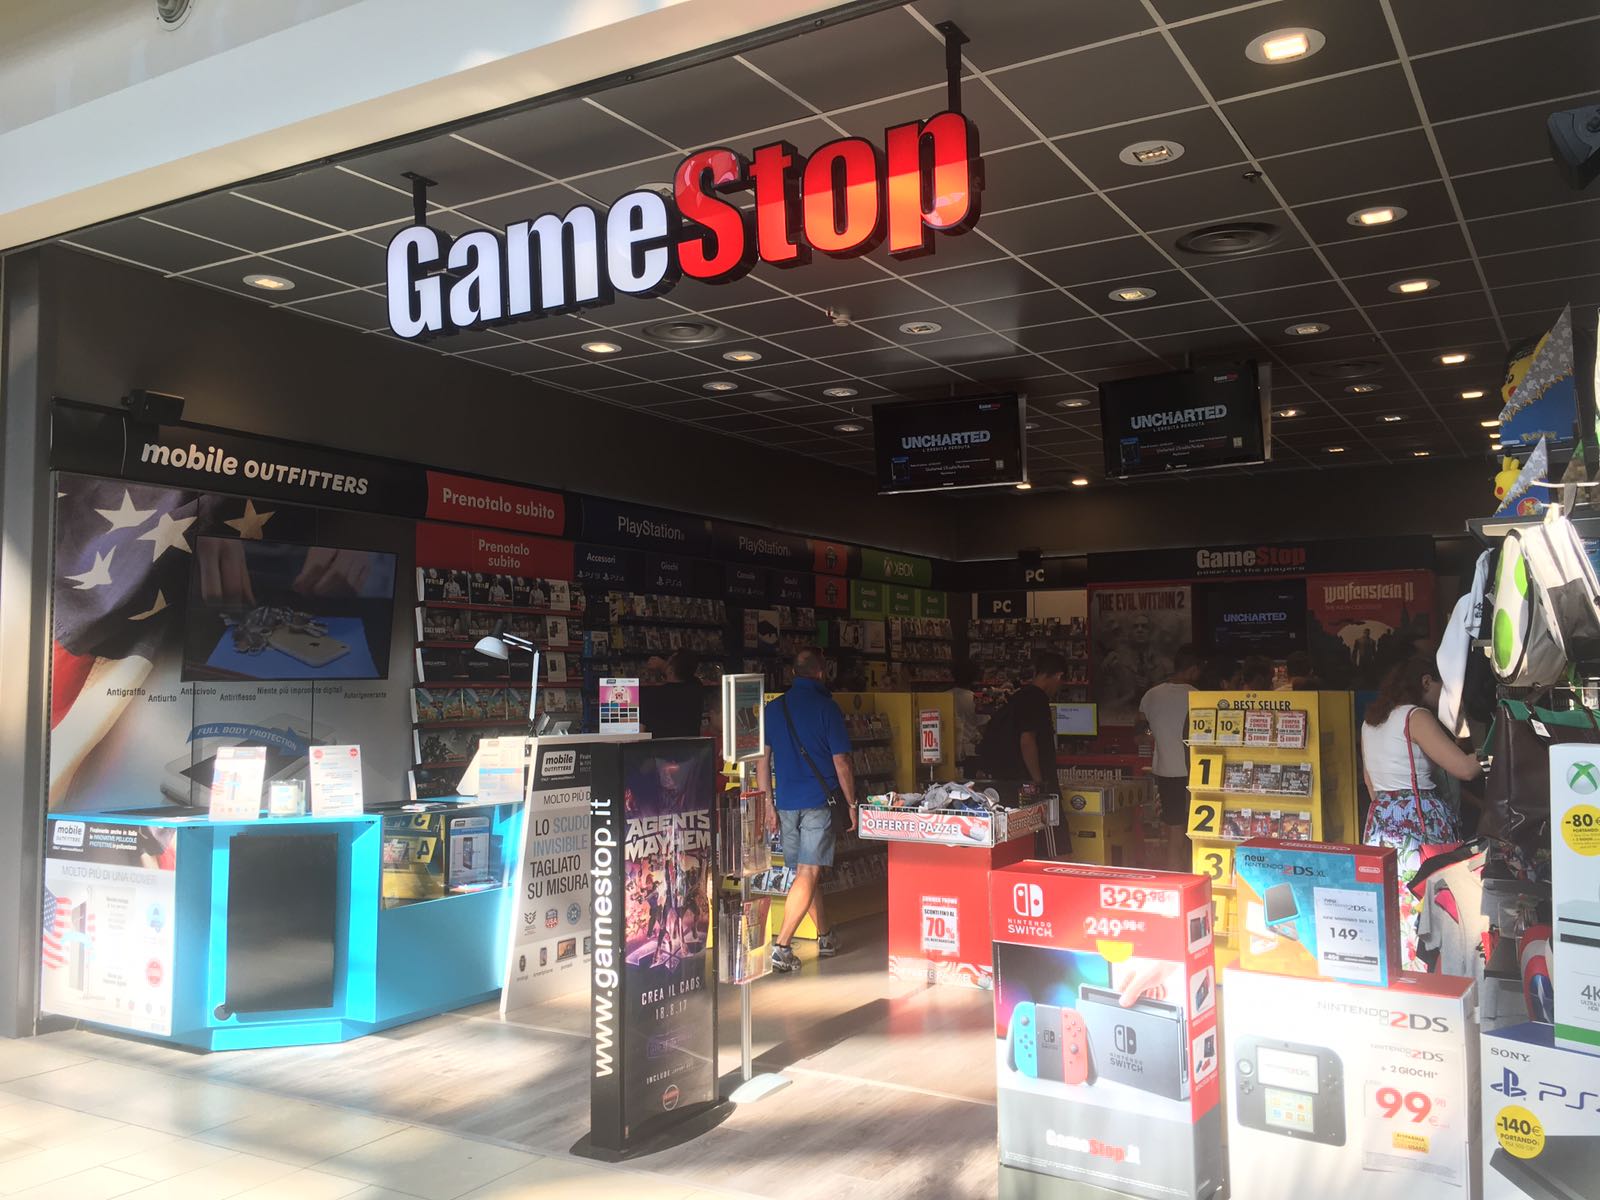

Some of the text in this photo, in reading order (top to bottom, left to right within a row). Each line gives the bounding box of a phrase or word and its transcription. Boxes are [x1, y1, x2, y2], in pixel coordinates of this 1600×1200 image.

[388, 111, 970, 338] GameStop
[1131, 405, 1227, 430] UNCHARTED
[902, 430, 990, 449] UNCHARTED
[141, 442, 368, 495] mobile OUTFITTERS
[443, 488, 554, 520] Prenotalo subito
[618, 516, 681, 540] PlayStation
[479, 539, 530, 556] Prenotalo
[739, 536, 788, 556] PlayStation
[488, 556, 520, 568] subito
[586, 552, 616, 564] Accessori
[1196, 547, 1306, 568] GameStop
[894, 562, 914, 576] XBOX
[1026, 569, 1044, 582] PC
[1096, 590, 1185, 610] THE EVIL WITHIN 2
[1322, 582, 1402, 604] wolfenstein
[993, 600, 1012, 613] PC
[1224, 612, 1287, 622] UNCHARTED
[106, 688, 146, 698] Antigraffio
[148, 694, 176, 702] Antiurto
[180, 688, 216, 696] Antscivolo
[1234, 700, 1291, 710] BEST SELLER
[1192, 720, 1205, 730] 10
[1220, 720, 1233, 732] 10
[198, 726, 297, 752] FULL BODY PROTECTION
[546, 754, 574, 764] mobile
[1198, 759, 1212, 785] 1
[544, 790, 591, 804] MOLTO PIÙ D
[536, 815, 590, 836] LO SCUDO
[625, 809, 710, 844] AGENTS
[867, 818, 960, 834] OFFERTE PAZZE
[1193, 805, 1216, 832] 2
[58, 825, 82, 835] mobile
[533, 834, 588, 858] INVISIBILE
[625, 830, 712, 862] MAYHEM
[530, 855, 580, 878] TAGLIATO
[1203, 853, 1223, 880] 3
[1245, 854, 1265, 862] new
[62, 866, 86, 878] MOLTO
[89, 868, 101, 879] PIÙ
[104, 870, 110, 880] DI
[112, 872, 128, 882] UNA
[1244, 862, 1326, 878] NINTENDO 2DS XL
[528, 874, 589, 900] SU MISURA
[1008, 918, 1052, 928] NINTENDO
[1008, 925, 1053, 937] SWITCH
[590, 798, 618, 1078] www.gamestop.it
[1330, 927, 1358, 940] 149
[642, 976, 700, 1006] CREA IL CAOS
[1581, 984, 1600, 1001] 4K
[1317, 1002, 1450, 1032] NINTENDO 2DS
[1411, 1049, 1444, 1062] 2DS
[1490, 1047, 1530, 1062] SONY
[1110, 1059, 1144, 1074] SWITCH
[1390, 1064, 1397, 1073] 2
[1376, 1086, 1432, 1123] 99
[1538, 1081, 1600, 1112] PS
[1497, 1116, 1542, 1137] -140€
[1500, 1133, 1538, 1146] PORTANDO
